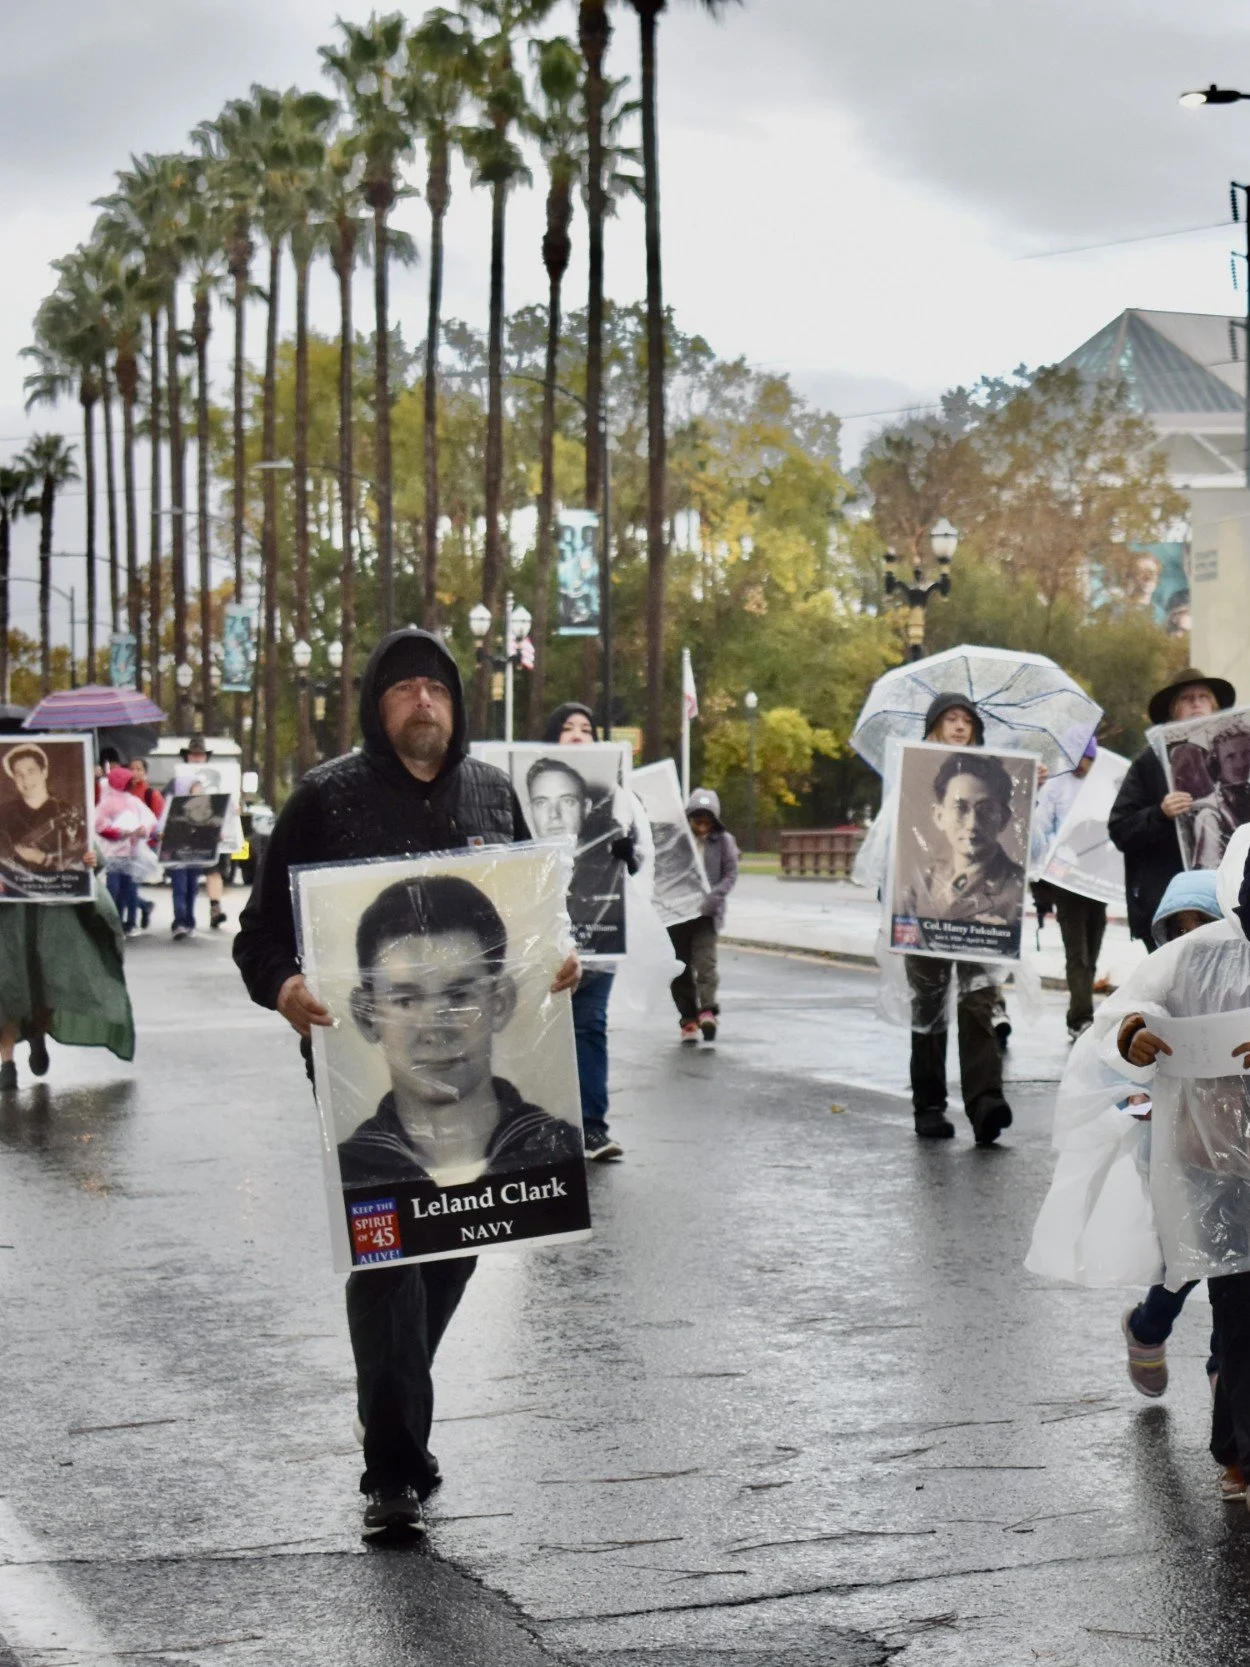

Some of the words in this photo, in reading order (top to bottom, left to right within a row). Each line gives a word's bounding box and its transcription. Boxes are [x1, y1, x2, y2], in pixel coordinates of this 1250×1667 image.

[409, 1187, 495, 1219] Leland
[500, 1177, 568, 1205] Clark
[351, 1204, 374, 1215] KEEP
[376, 1201, 394, 1211] THE
[354, 1214, 395, 1231] SPIRIT
[460, 1220, 514, 1242] NAVY
[359, 1249, 401, 1265] ALIVE!
